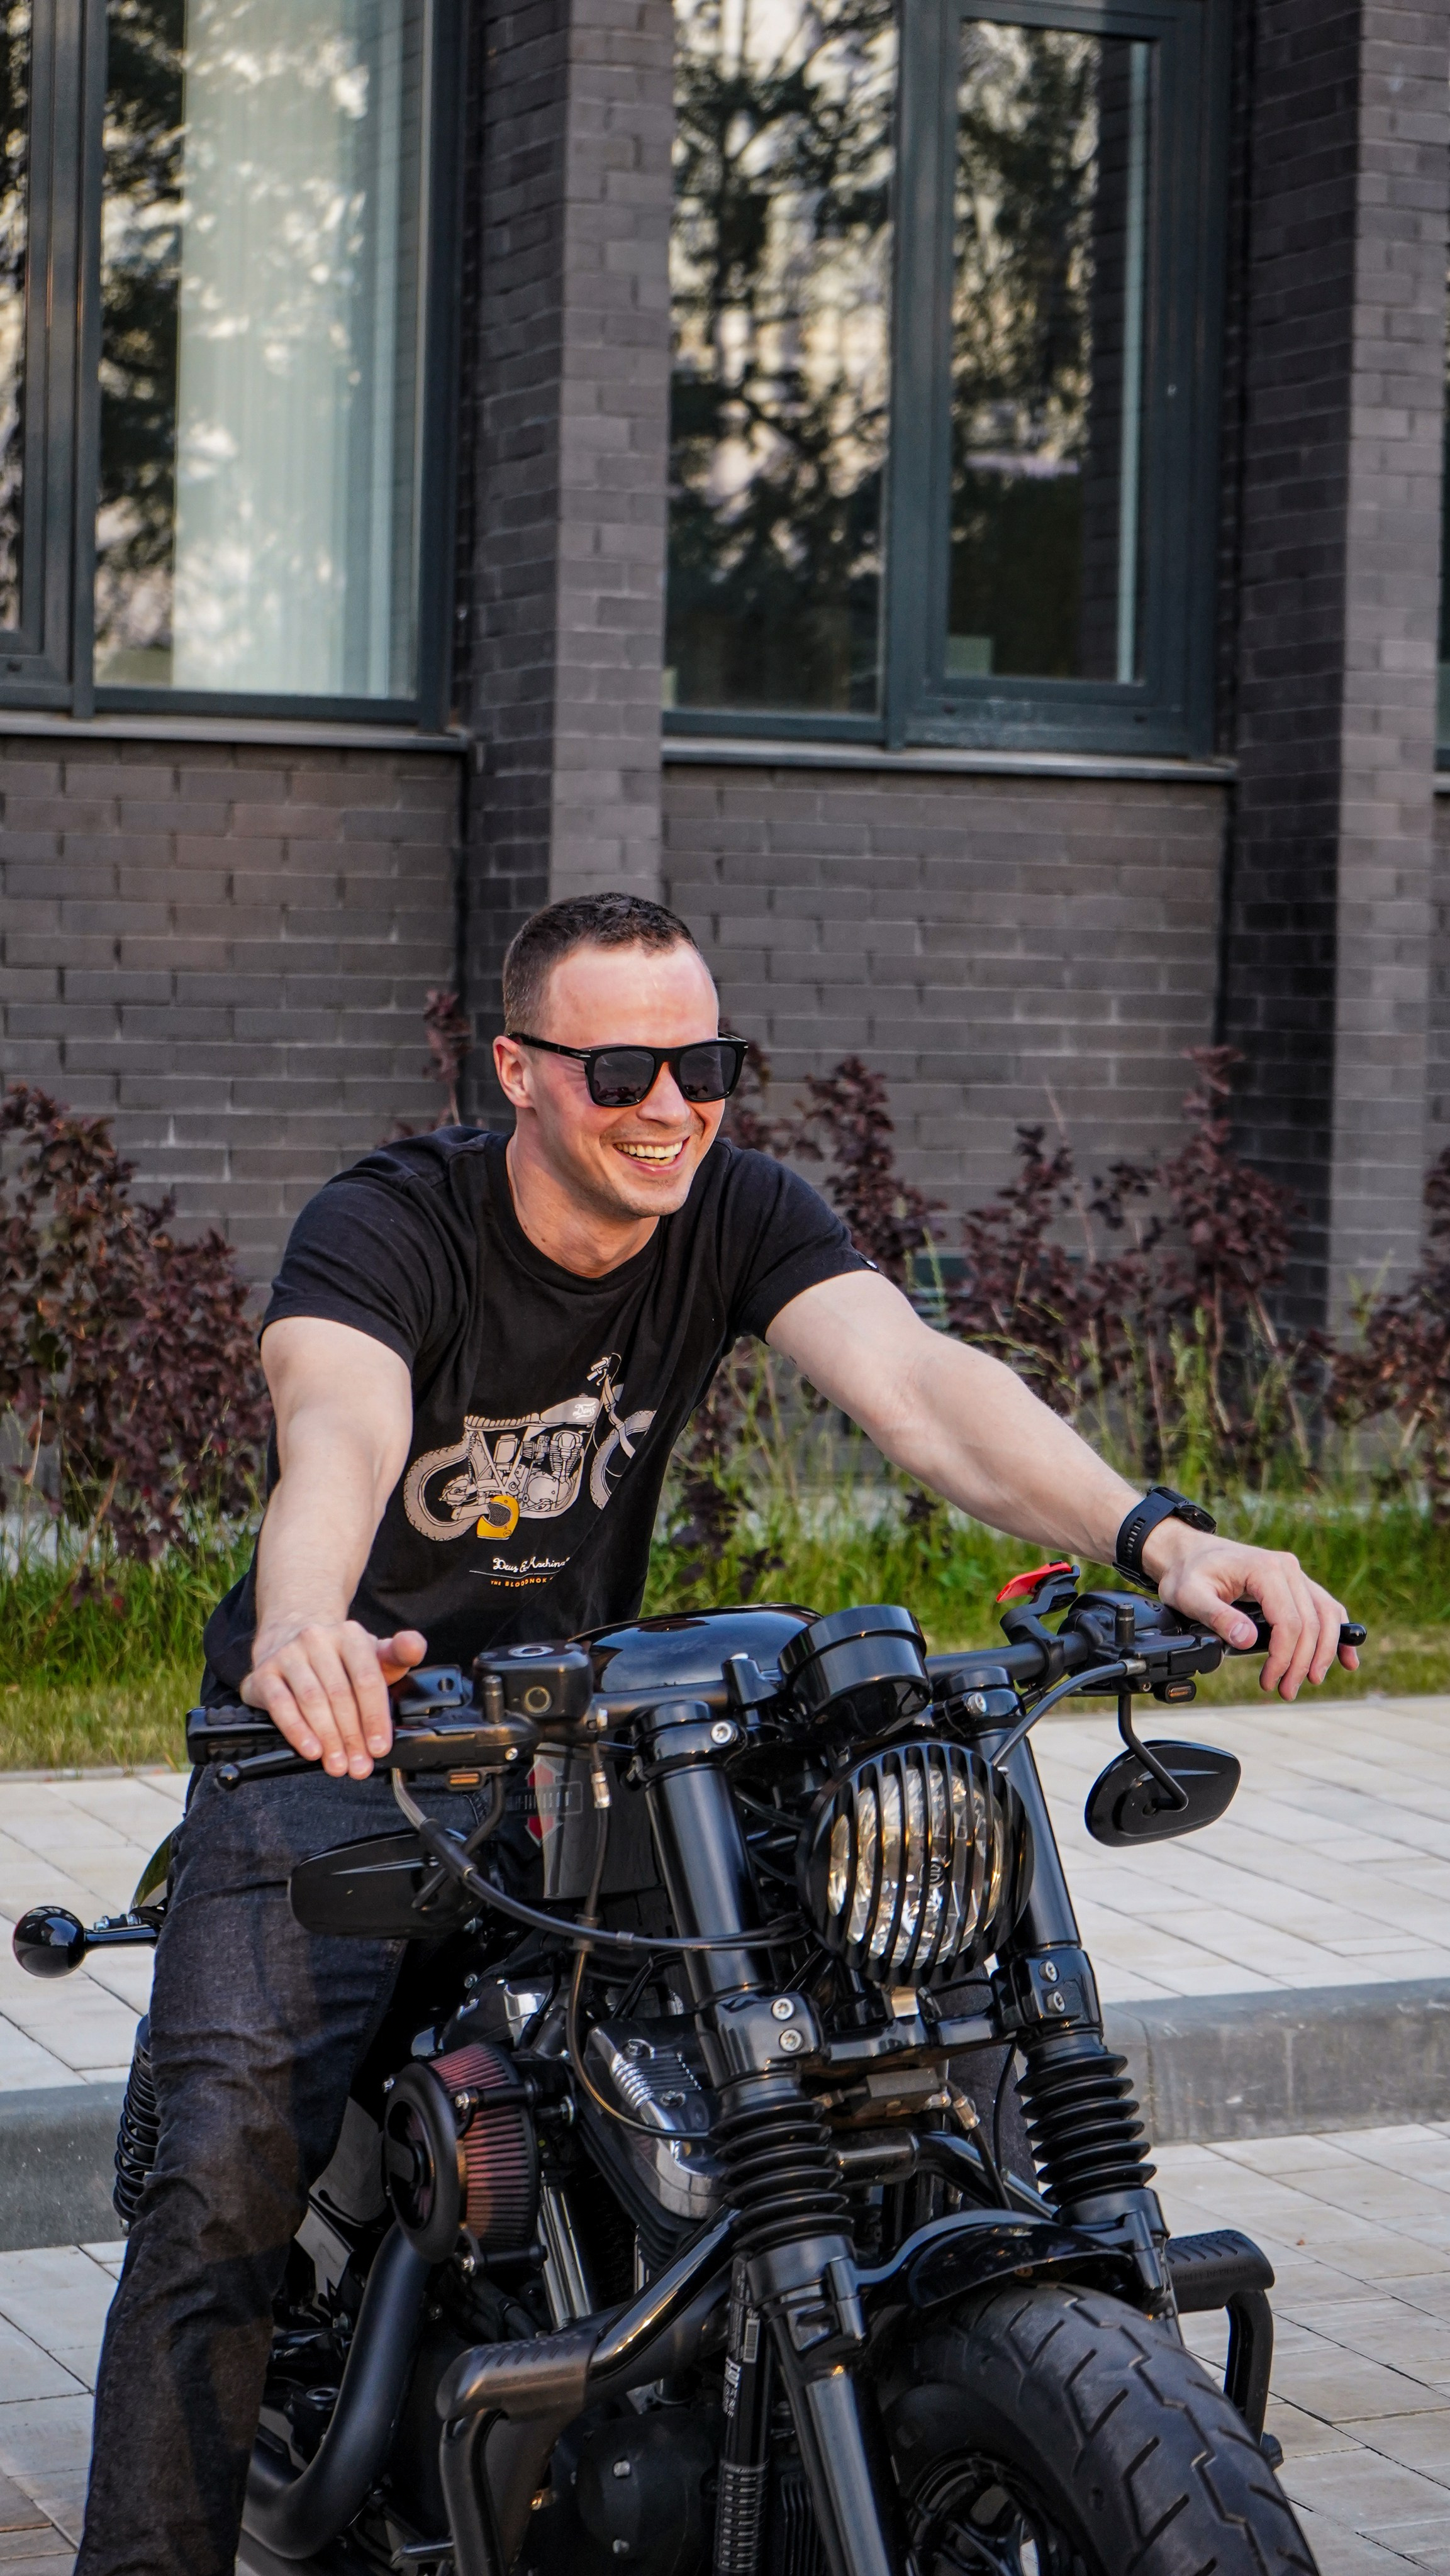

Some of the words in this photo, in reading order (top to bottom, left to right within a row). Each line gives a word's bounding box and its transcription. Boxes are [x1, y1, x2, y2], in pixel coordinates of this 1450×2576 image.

[572, 1402, 596, 1419] Deus
[493, 1558, 519, 1573] Deus
[505, 1577, 547, 1588] BLOODNOK
